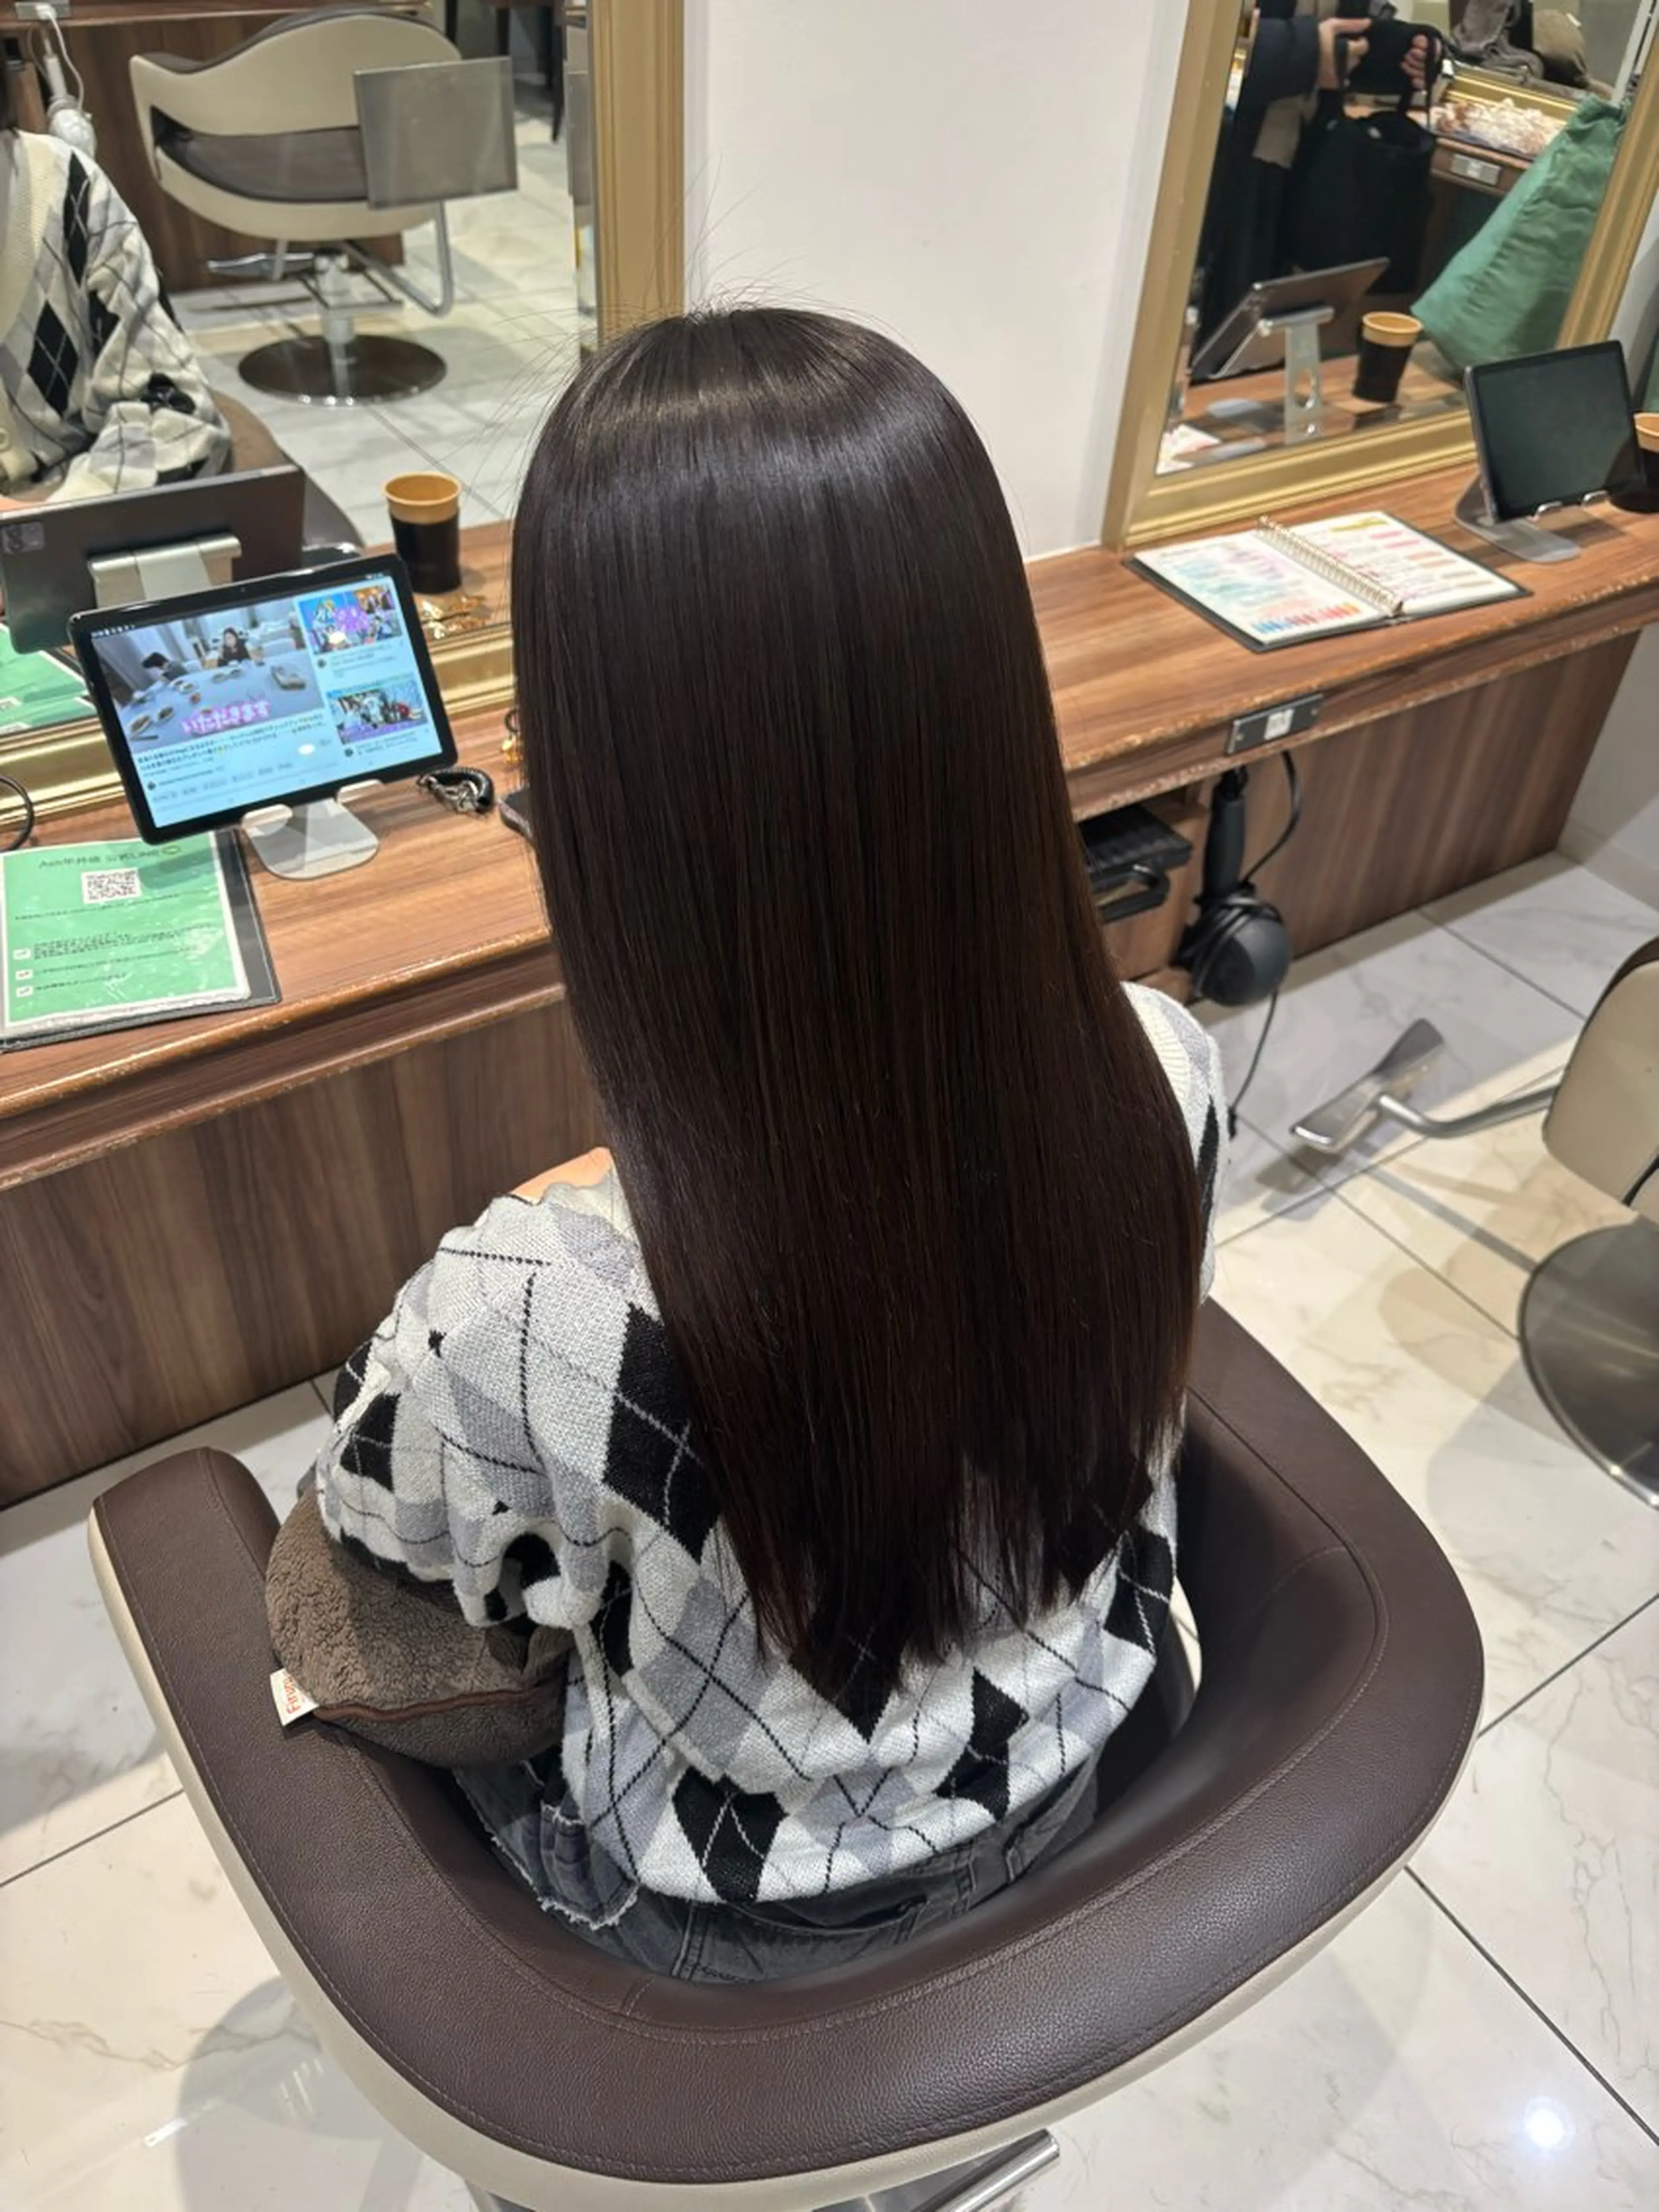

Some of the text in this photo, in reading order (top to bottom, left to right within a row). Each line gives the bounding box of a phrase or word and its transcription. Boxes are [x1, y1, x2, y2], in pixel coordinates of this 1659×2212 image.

[180, 699, 272, 734] いただきます
